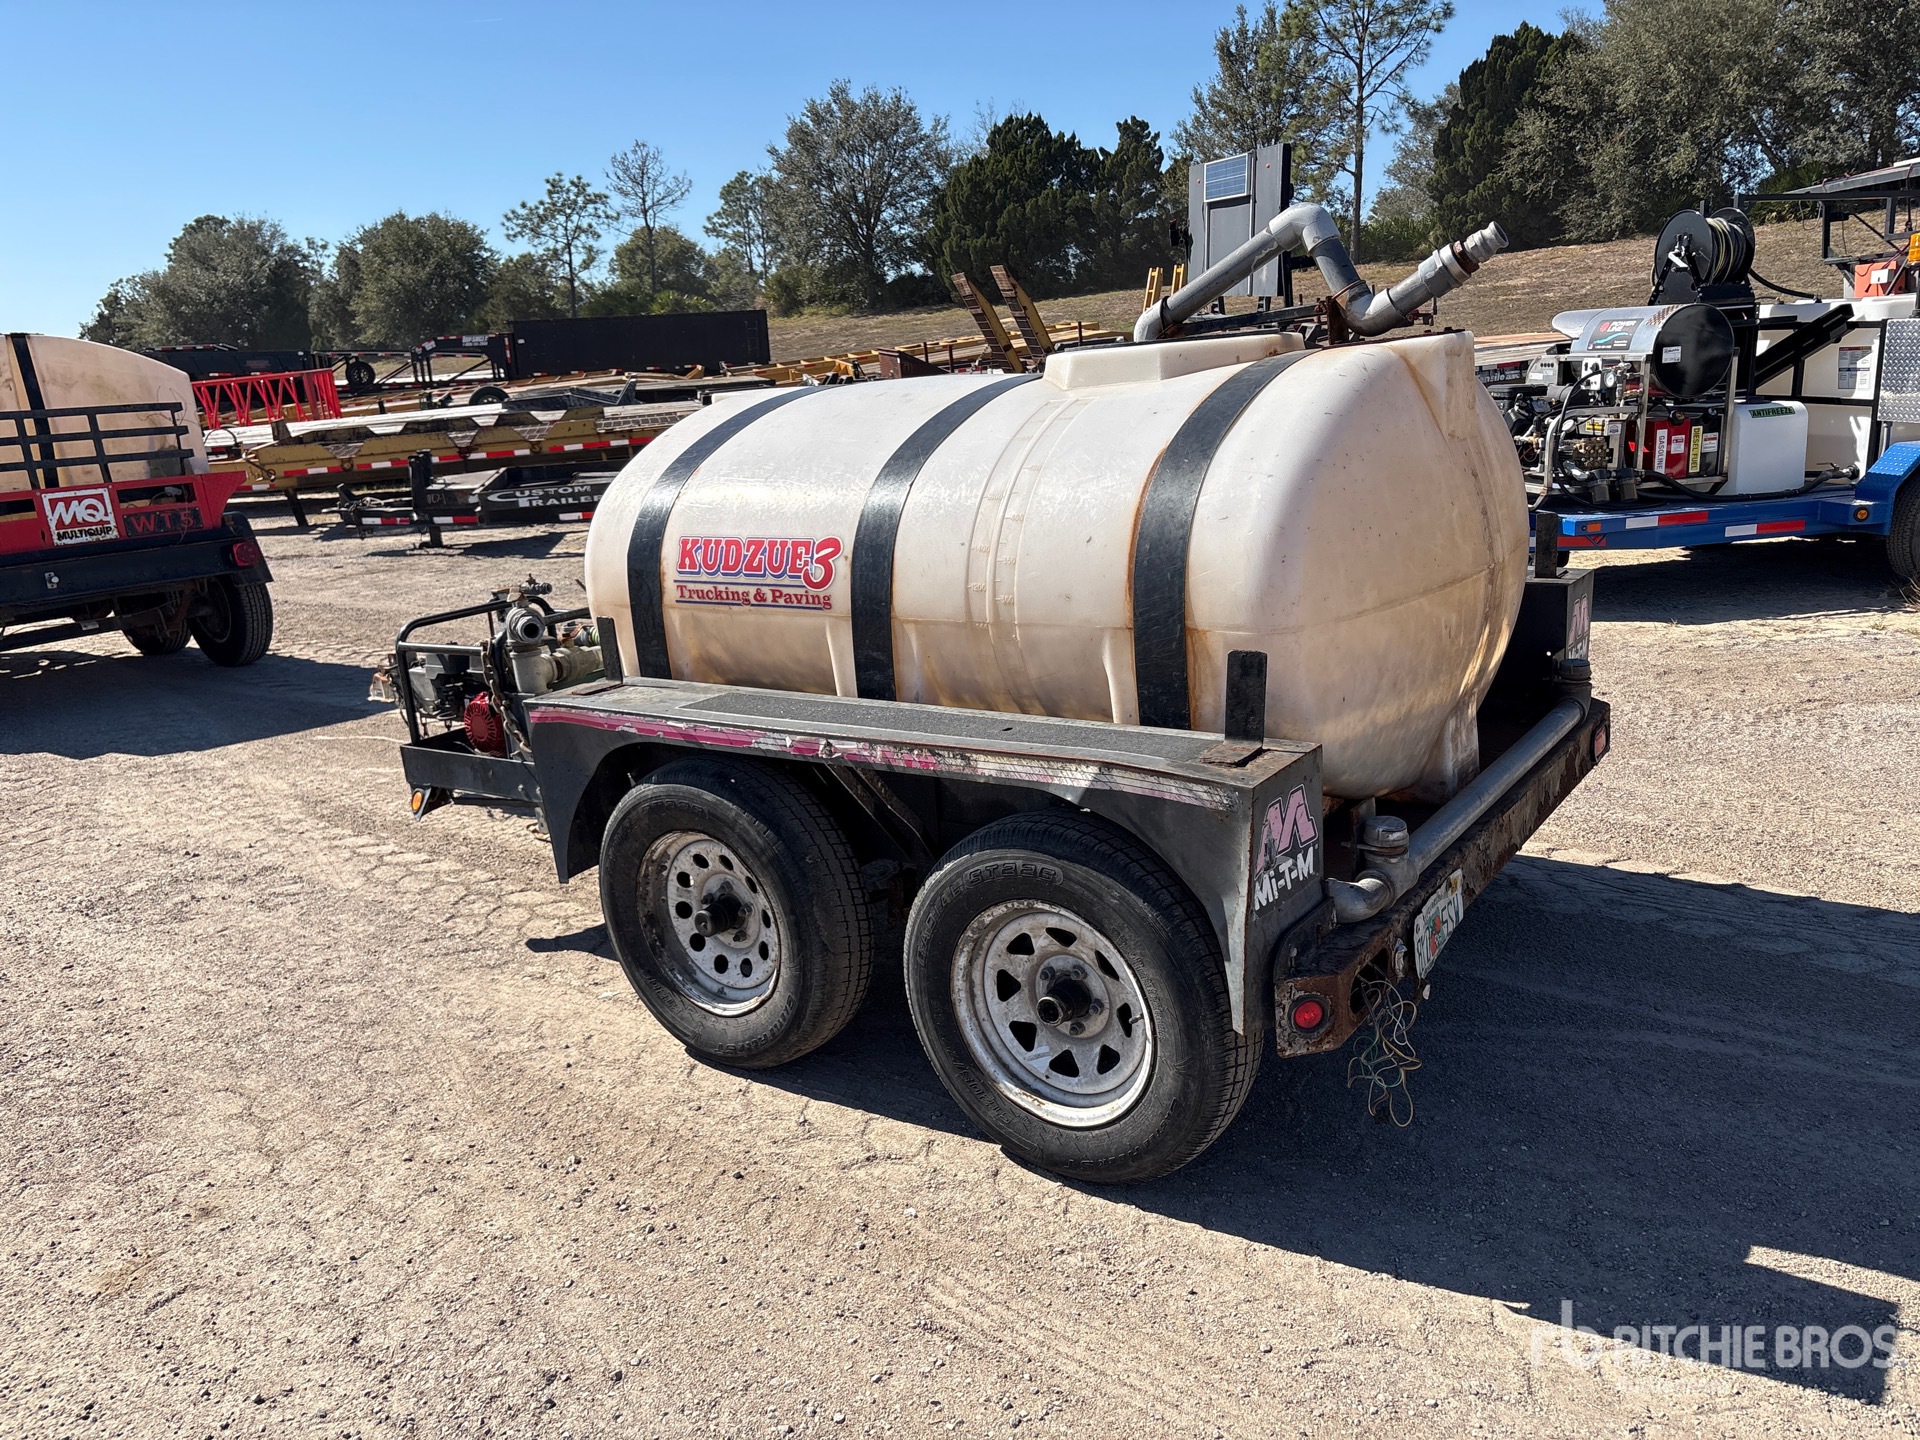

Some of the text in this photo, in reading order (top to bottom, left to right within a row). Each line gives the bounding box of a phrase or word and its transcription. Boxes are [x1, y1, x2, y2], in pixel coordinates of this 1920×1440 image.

[1752, 406, 1793, 417] ANTIFREEZE
[1656, 435, 1666, 470] GASOLINE
[1691, 427, 1701, 470] DIESEL FUEL
[57, 526, 113, 541] MULTIQUIP
[676, 585, 832, 610] Trucking & Paving
